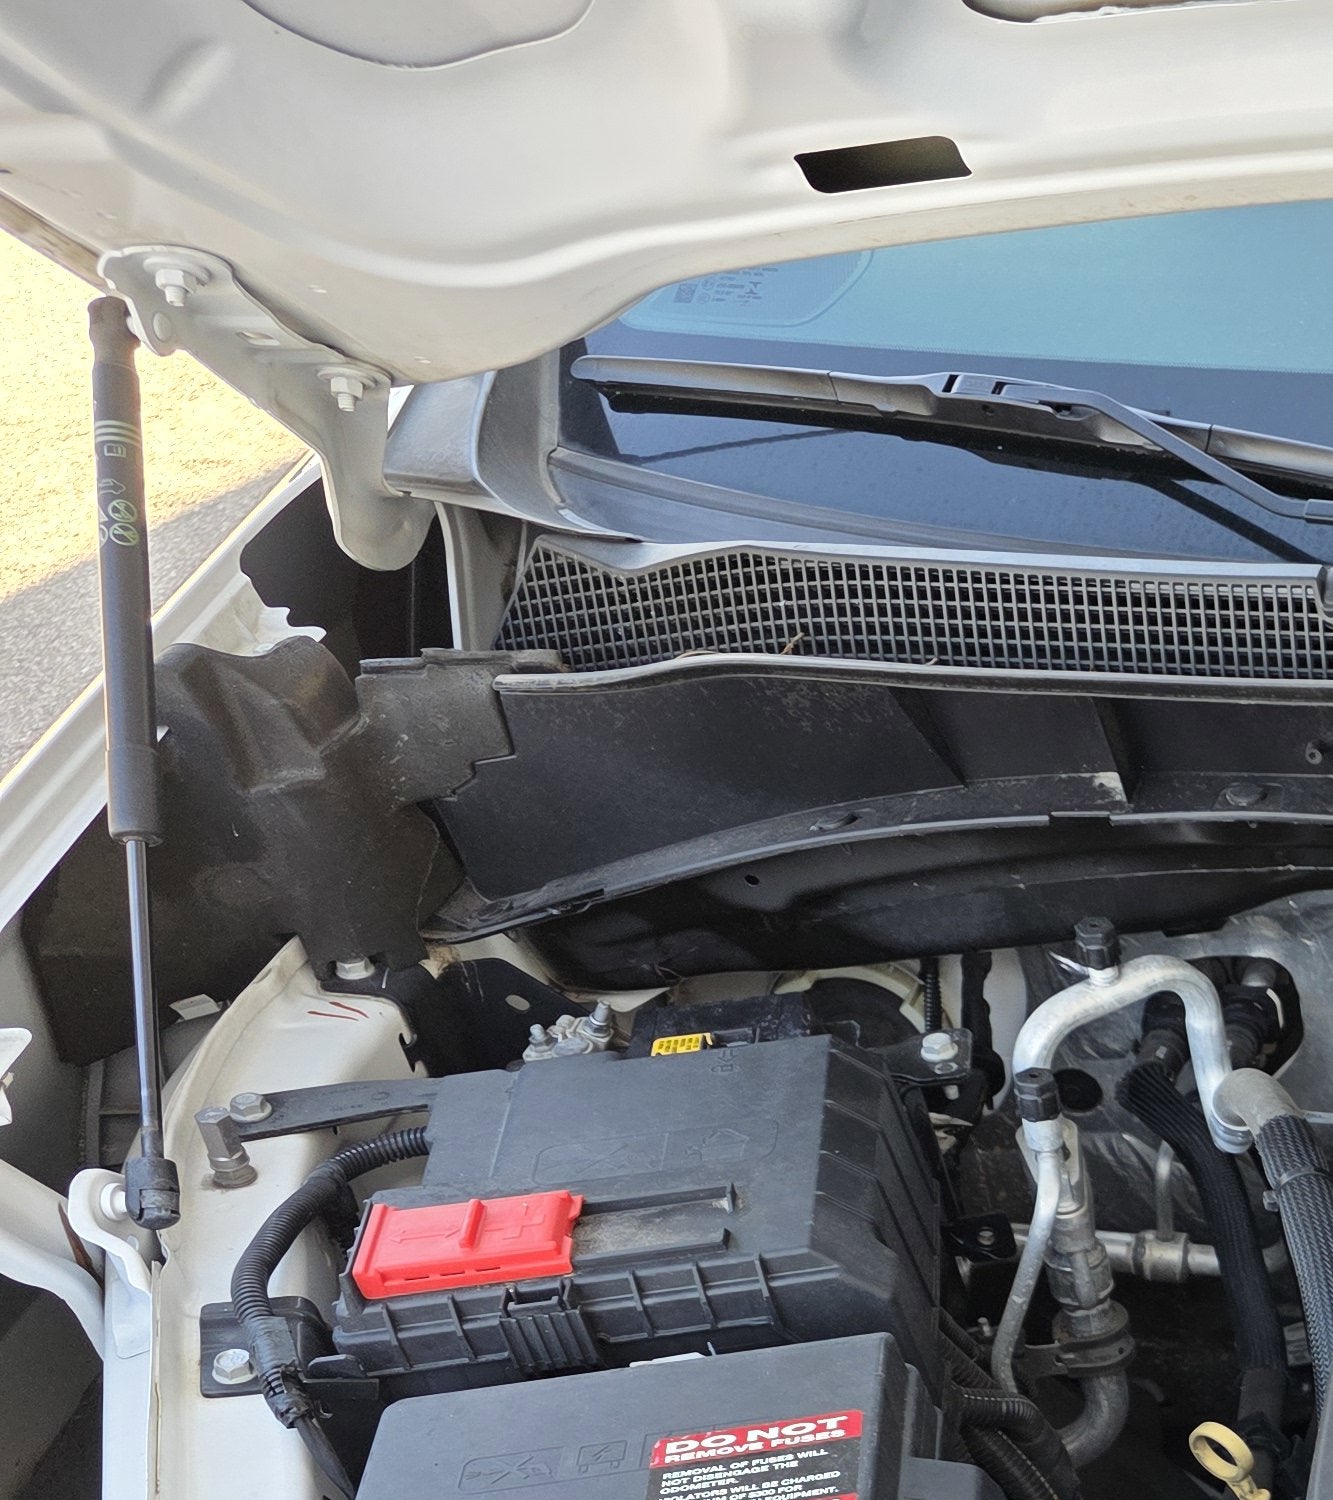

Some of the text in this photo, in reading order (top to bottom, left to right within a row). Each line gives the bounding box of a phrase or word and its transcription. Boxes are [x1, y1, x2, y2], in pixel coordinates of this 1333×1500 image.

[665, 1416, 848, 1455] DO NOT
[665, 1429, 845, 1463] REMOVE FUSES
[662, 1460, 798, 1487] NOT DISENGAGE THE
[663, 1449, 829, 1480] REMOVAL OF FUSES WILL
[660, 1478, 739, 1494] ODOMETER.
[729, 1493, 746, 1500] OF
[778, 1485, 802, 1493] FOR
[730, 1484, 759, 1493] WILL
[781, 1471, 840, 1486] CHARGED
